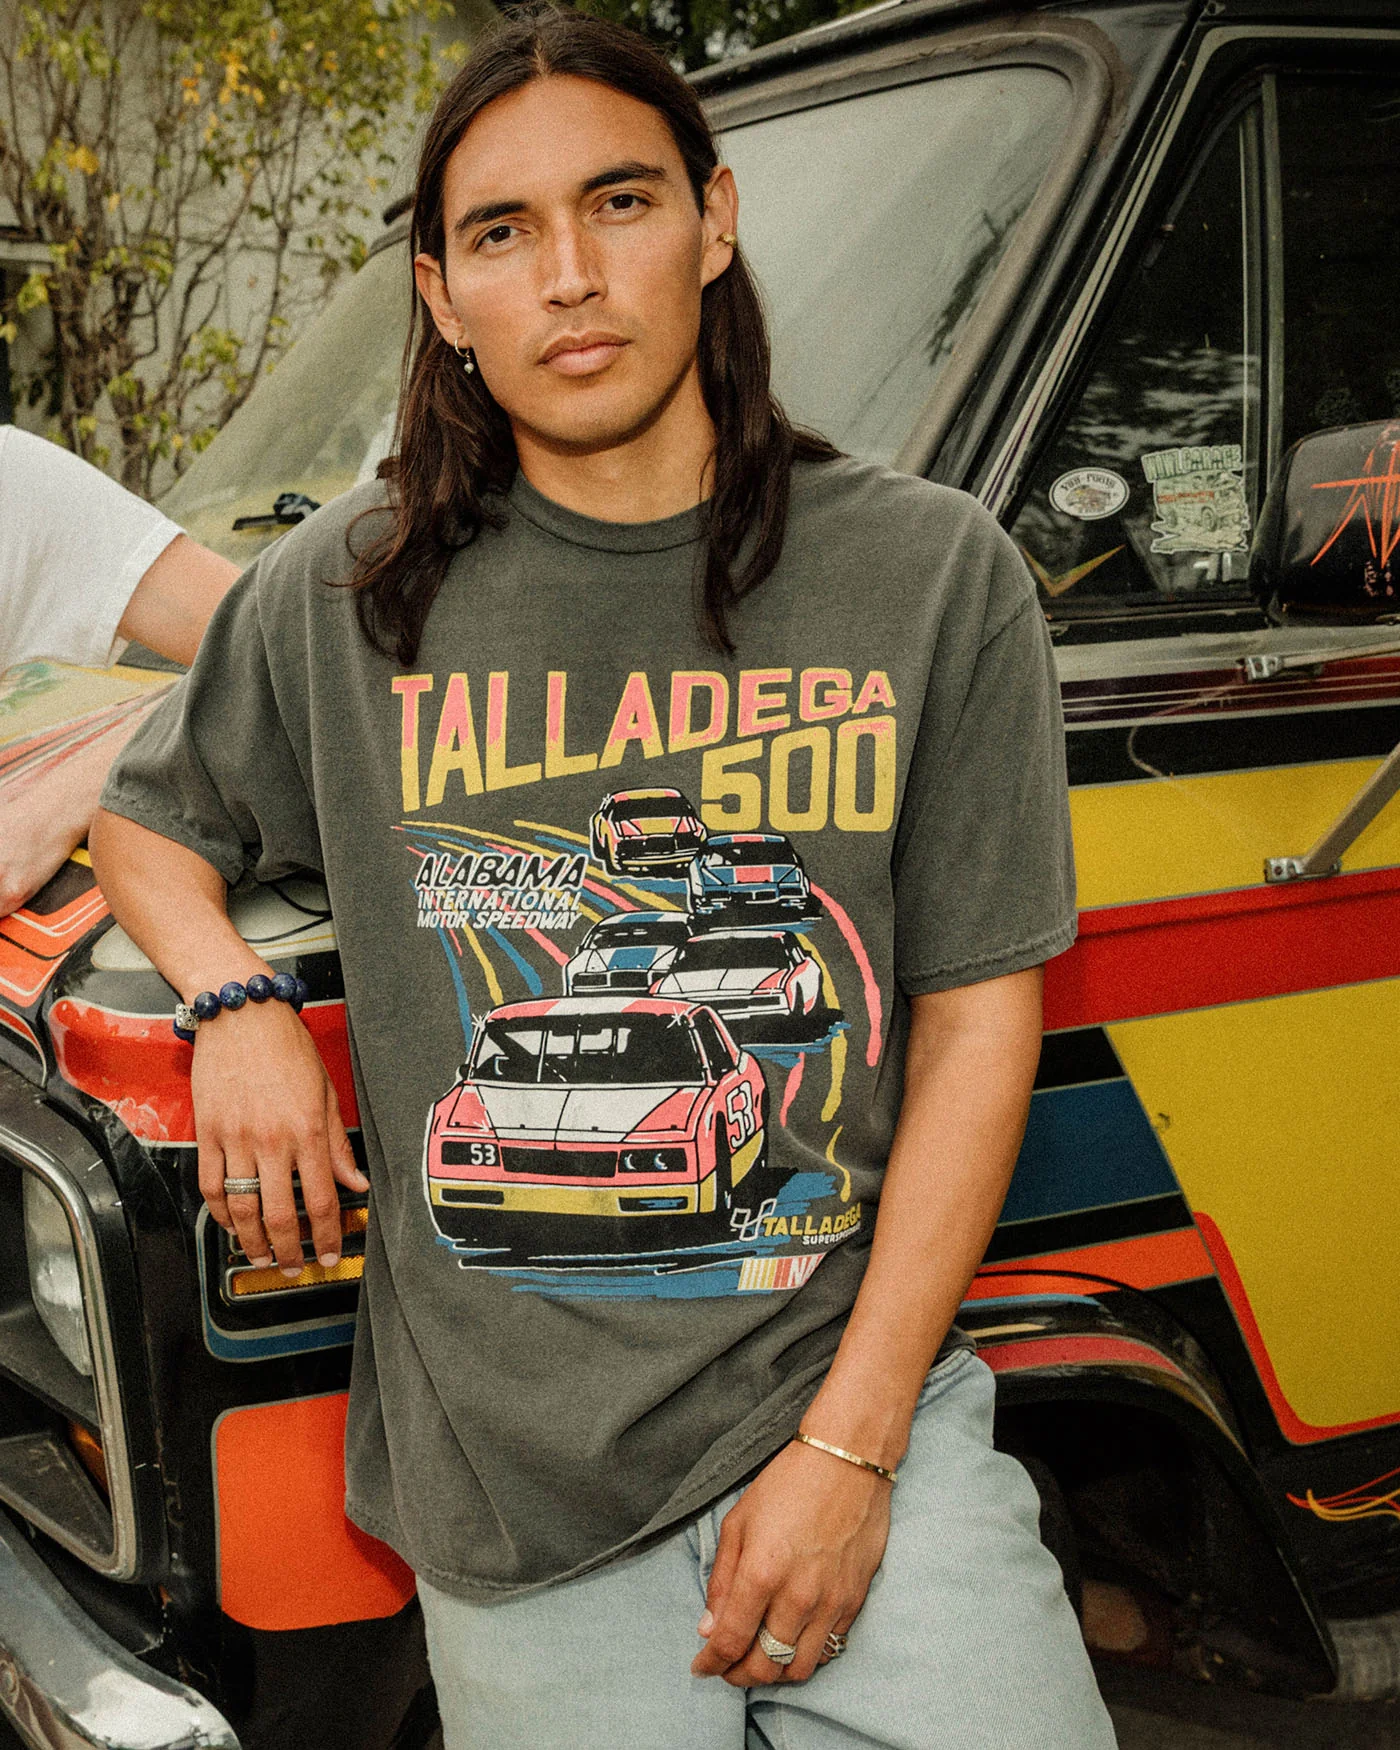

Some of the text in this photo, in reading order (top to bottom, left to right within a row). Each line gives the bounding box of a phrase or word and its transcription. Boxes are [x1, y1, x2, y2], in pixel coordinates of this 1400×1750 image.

[391, 668, 897, 812] TALLADEGA
[701, 715, 897, 832] 500
[415, 853, 588, 890] ALABAMA
[418, 890, 582, 910] INTERNATIONAL
[417, 910, 583, 930] MOTOR SPEEDWAY
[727, 1081, 756, 1149] 53
[470, 1144, 496, 1166] 53
